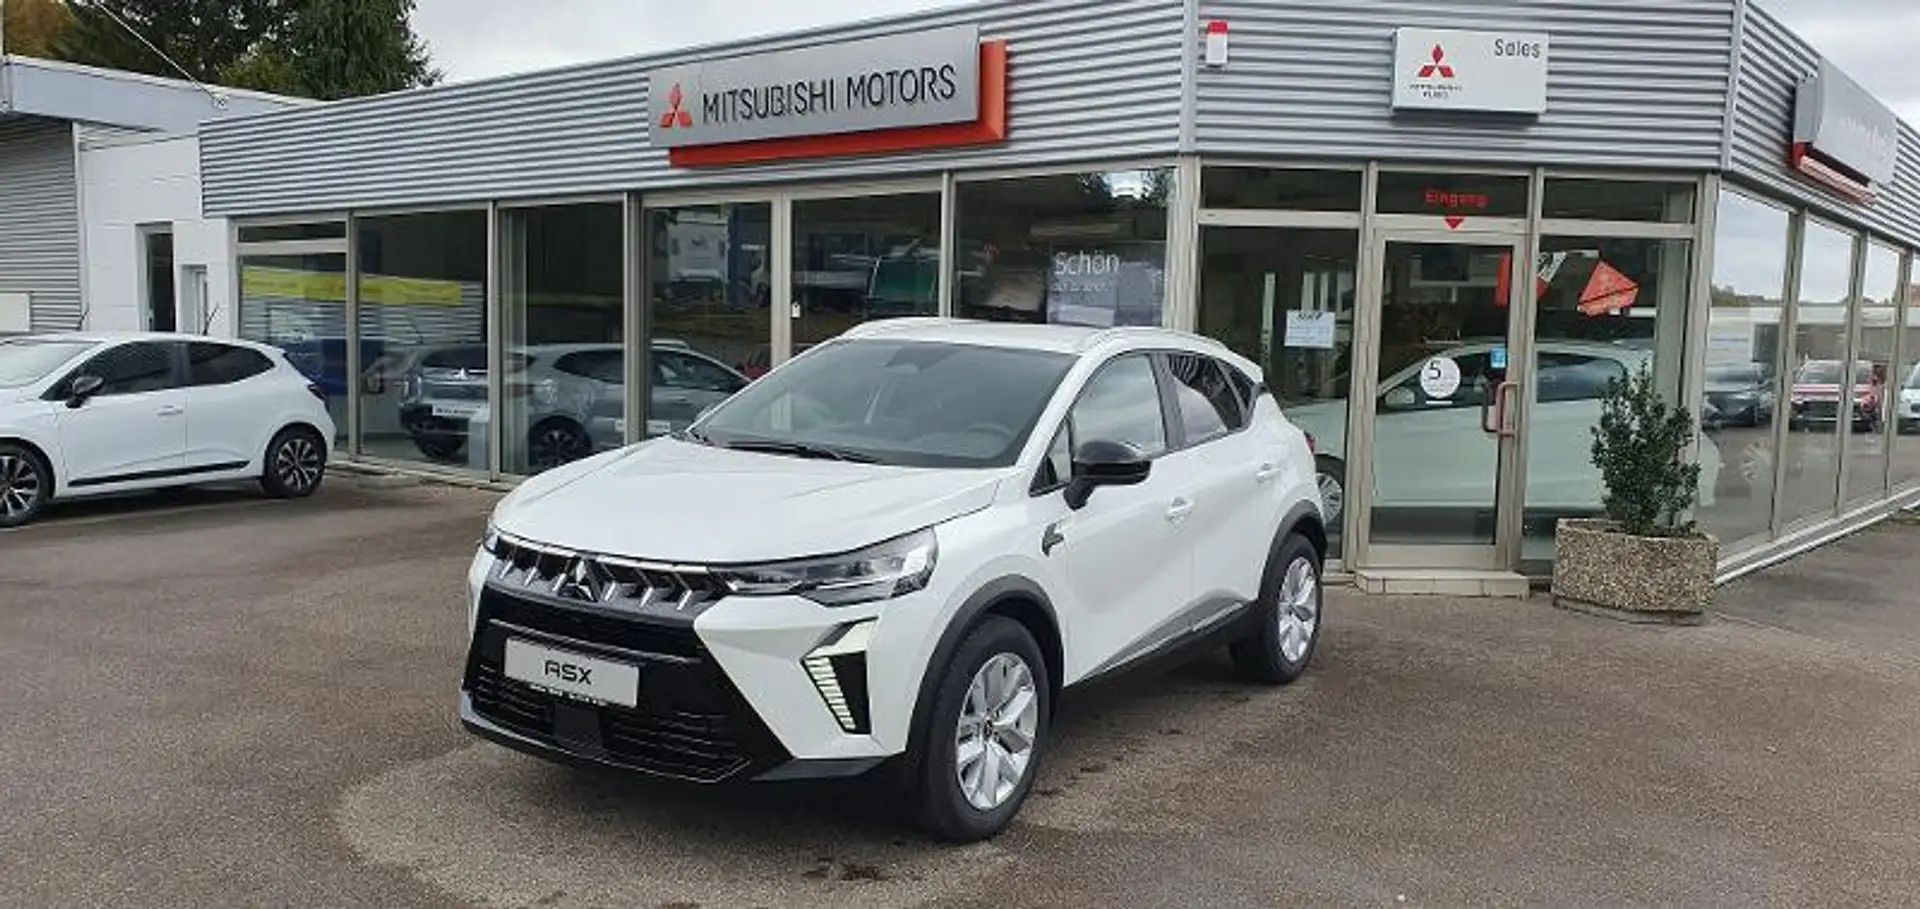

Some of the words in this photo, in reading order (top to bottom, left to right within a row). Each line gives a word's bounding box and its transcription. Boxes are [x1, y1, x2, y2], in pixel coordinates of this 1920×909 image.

[1494, 38, 1541, 59] Sales
[702, 78, 836, 124] MITSUBISHI
[846, 65, 957, 110] MOTORS
[1424, 189, 1488, 208] Eingang
[1054, 249, 1120, 276] Schön
[545, 660, 593, 684] ASX
